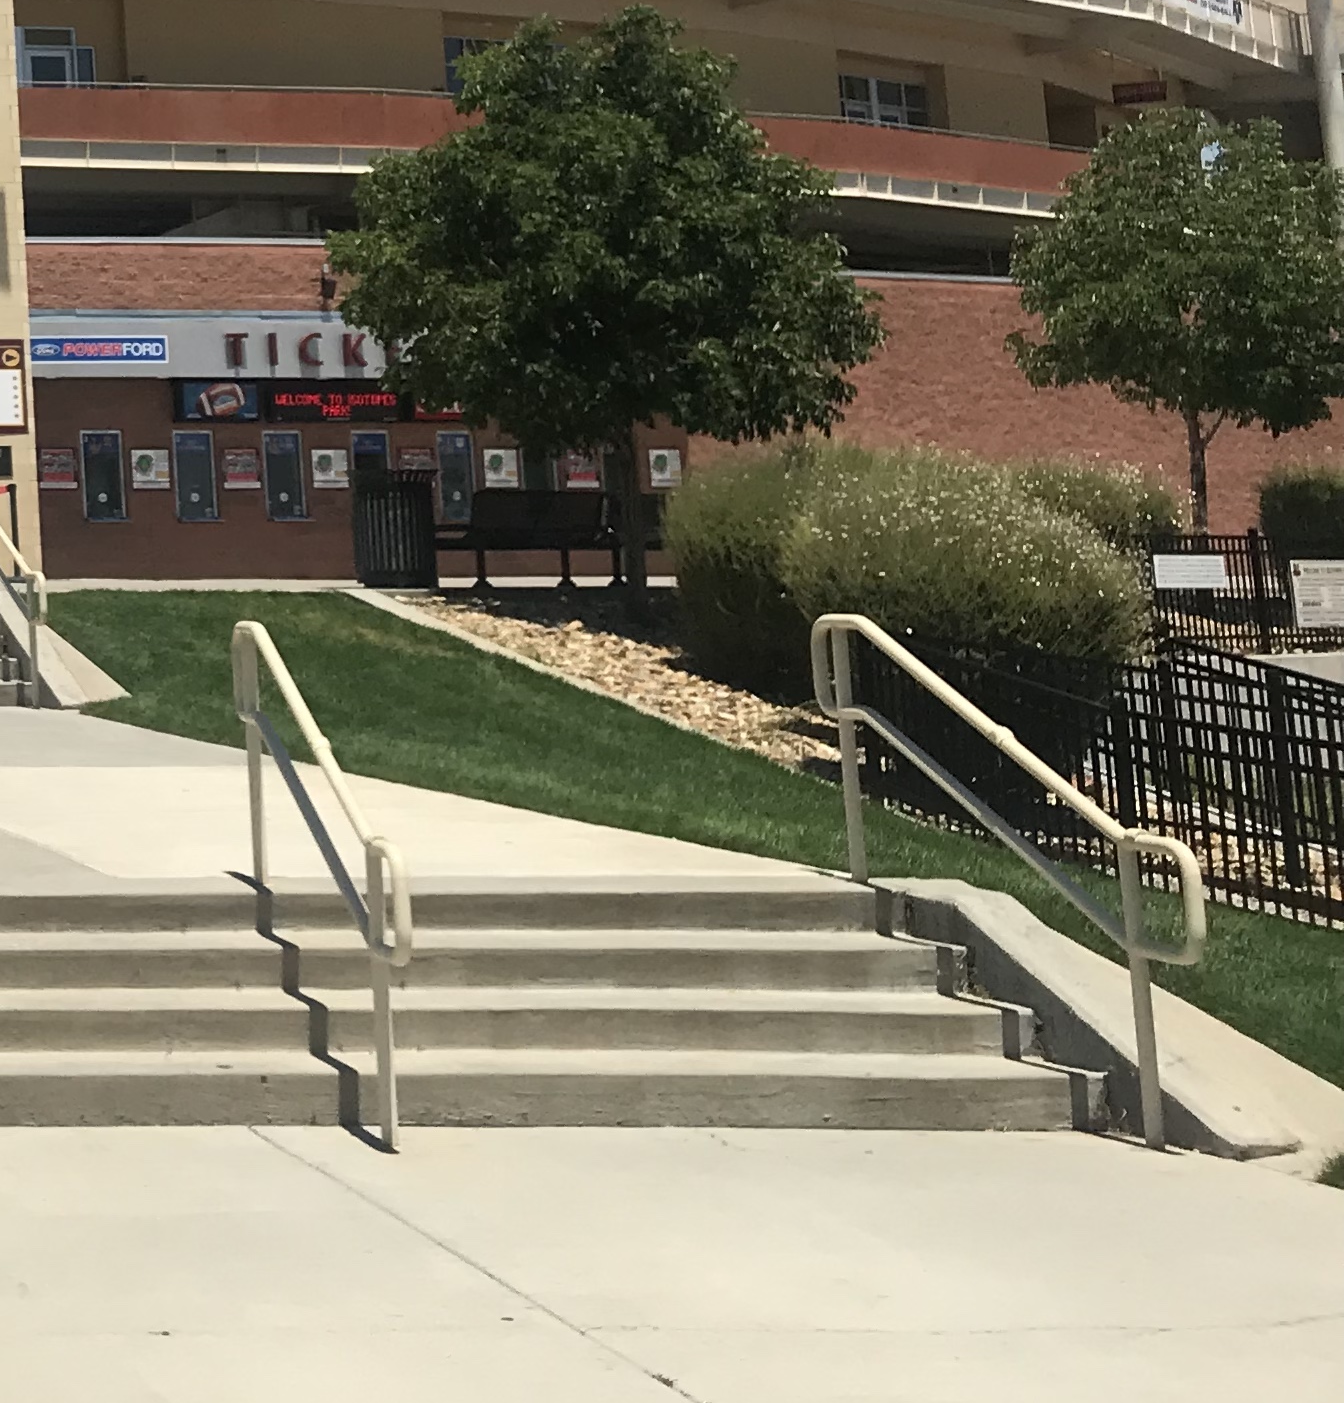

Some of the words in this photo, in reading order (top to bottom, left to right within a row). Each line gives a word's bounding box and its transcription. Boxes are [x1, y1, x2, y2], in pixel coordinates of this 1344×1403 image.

[274, 394, 322, 406] WELCOME
[328, 394, 343, 405] TO
[348, 393, 397, 406] ISOTOPES
